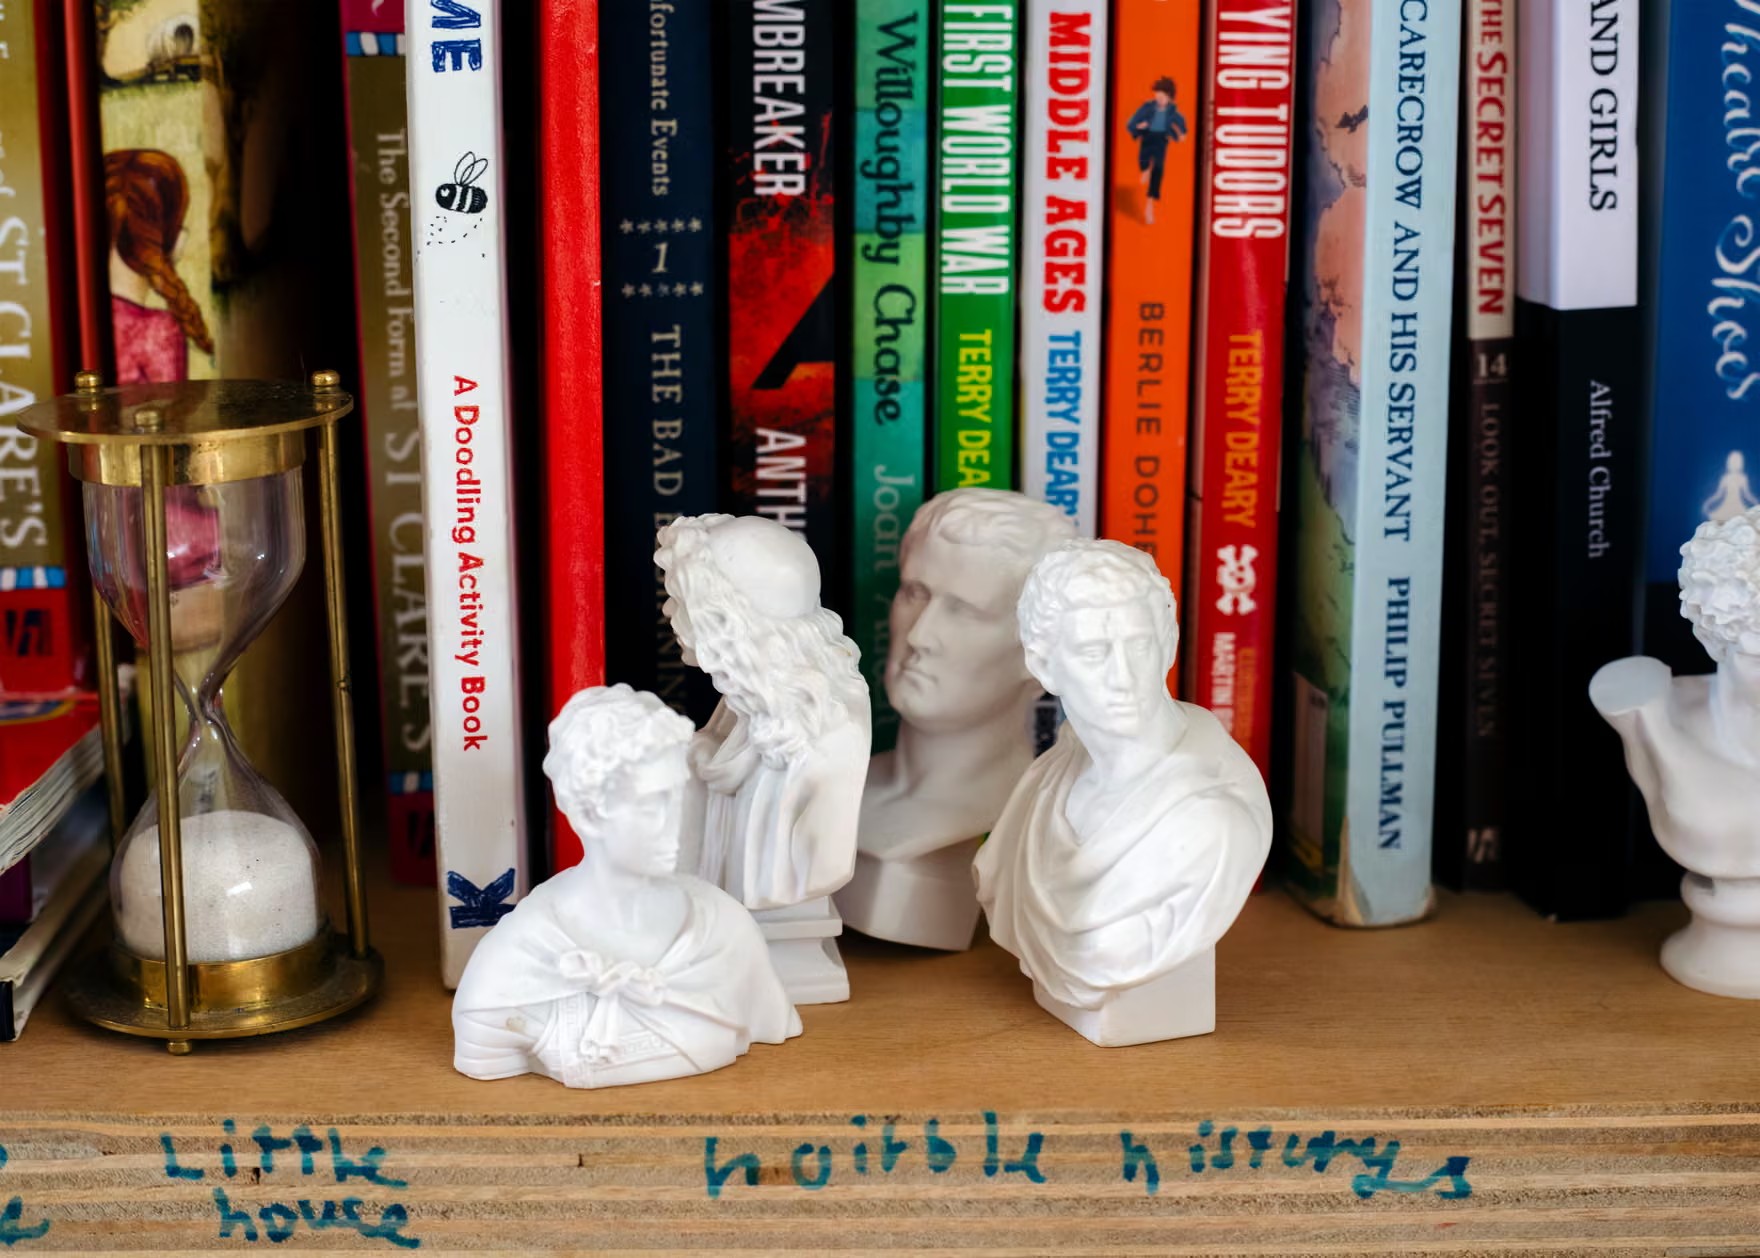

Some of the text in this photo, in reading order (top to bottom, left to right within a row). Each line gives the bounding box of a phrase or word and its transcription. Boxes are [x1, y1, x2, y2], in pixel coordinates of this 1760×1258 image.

[376, 130, 405, 184] The
[650, 0, 678, 196] fortunate Events
[941, 4, 1013, 294] FIRST WORLD WAR
[1043, 11, 1092, 313] MIDDLE AGES
[1212, 0, 1292, 239] YING TUDORS
[1477, 51, 1507, 188] SECRET
[1588, 88, 1618, 212] GIRLS
[380, 192, 413, 298] Second
[859, 11, 919, 426] Willoughby Chase
[1391, 221, 1420, 301] AND
[1478, 194, 1505, 316] SEVEN
[651, 325, 682, 404] THE
[956, 329, 993, 489] TERRY DEA
[1389, 312, 1418, 373] HIS
[1477, 353, 1508, 378] 14
[653, 419, 683, 496] BAD
[755, 427, 808, 544] ANTH
[1045, 330, 1082, 526] TERRY DEAR
[1133, 302, 1166, 569] BERLIE DOHE
[1221, 328, 1263, 529] TERRY DEARY
[1384, 382, 1416, 542] SERVANT
[1481, 403, 1500, 476] LOOK
[1588, 380, 1613, 558] Alfred Church
[451, 375, 488, 751] A Doodling Activity Book
[873, 464, 915, 572] Joan
[389, 511, 432, 750] CLARES
[1378, 576, 1410, 850] PHILIP PULLMAN
[213, 1187, 421, 1249] house
